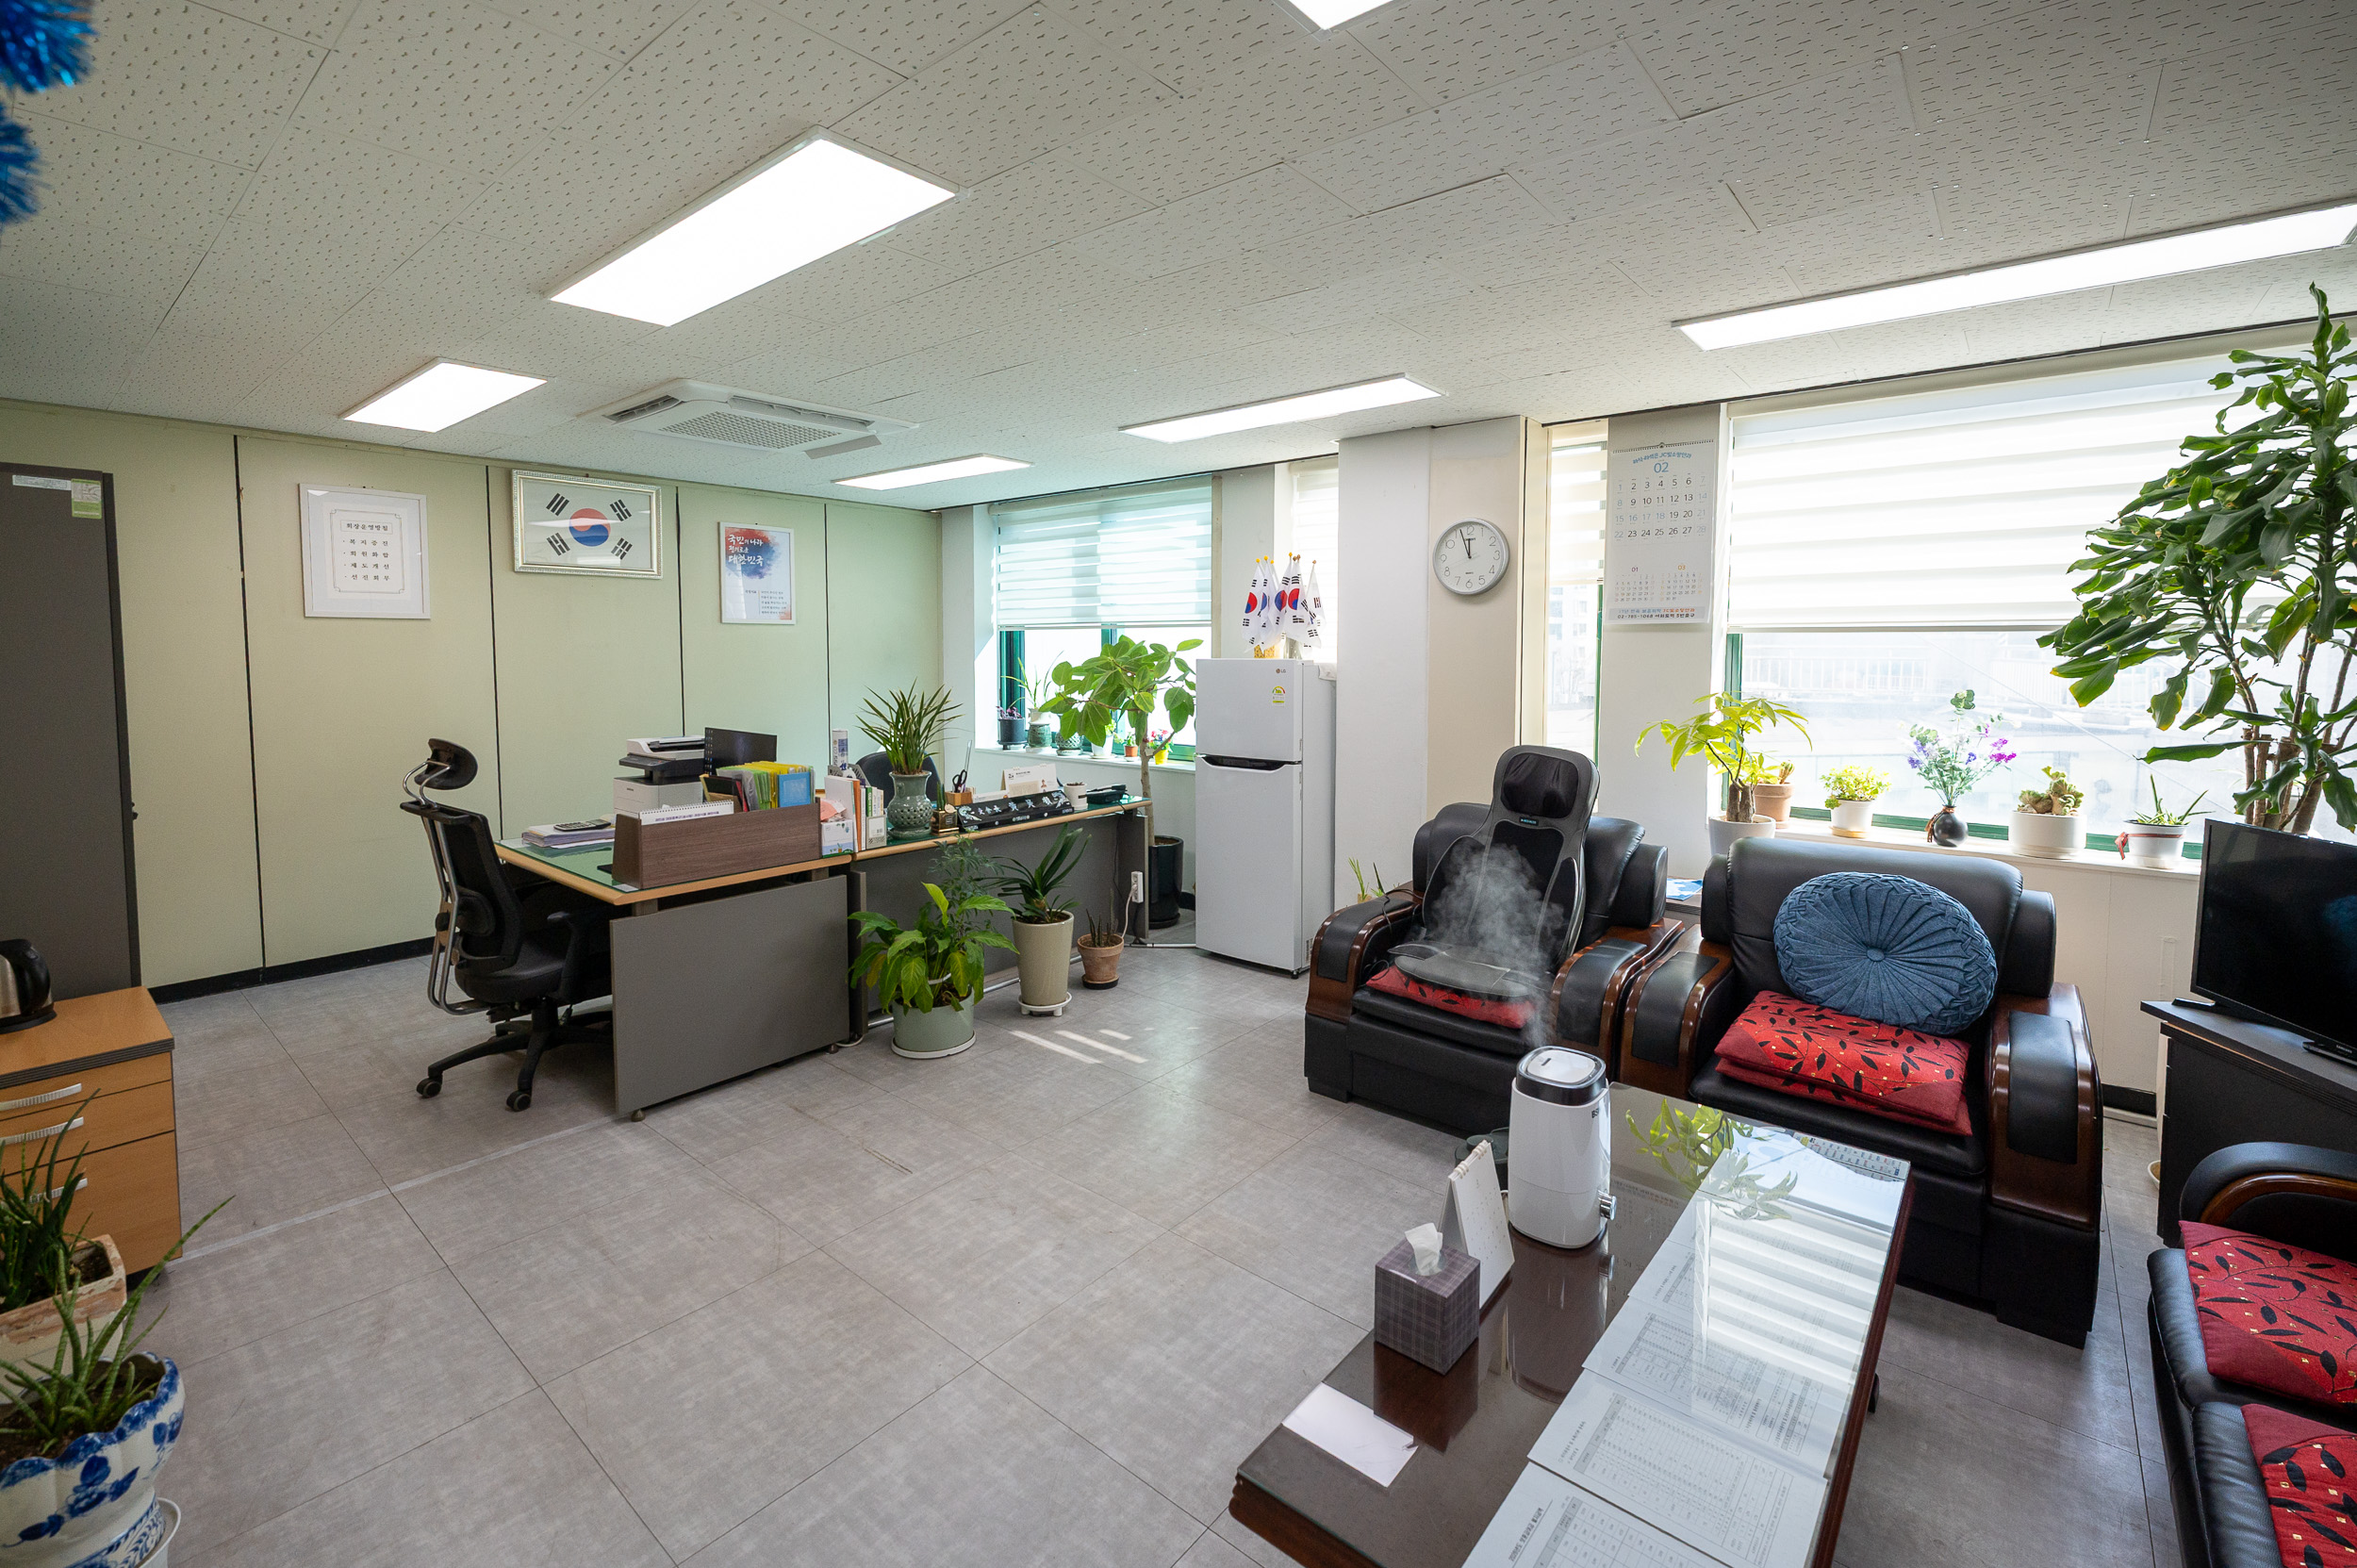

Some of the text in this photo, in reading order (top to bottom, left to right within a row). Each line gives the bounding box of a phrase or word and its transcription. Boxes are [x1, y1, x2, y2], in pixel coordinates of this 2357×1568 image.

[1654, 462, 1669, 473] 02
[728, 534, 749, 545] 국민의
[1489, 536, 1497, 546] 2
[728, 554, 764, 566] 대한민국
[1440, 554, 1447, 563] 9
[1493, 550, 1500, 560] 3
[1444, 566, 1450, 576] 8
[1489, 565, 1495, 574] 4
[1455, 576, 1461, 585] 7
[1466, 579, 1473, 589] 6
[1478, 575, 1485, 585] 5
